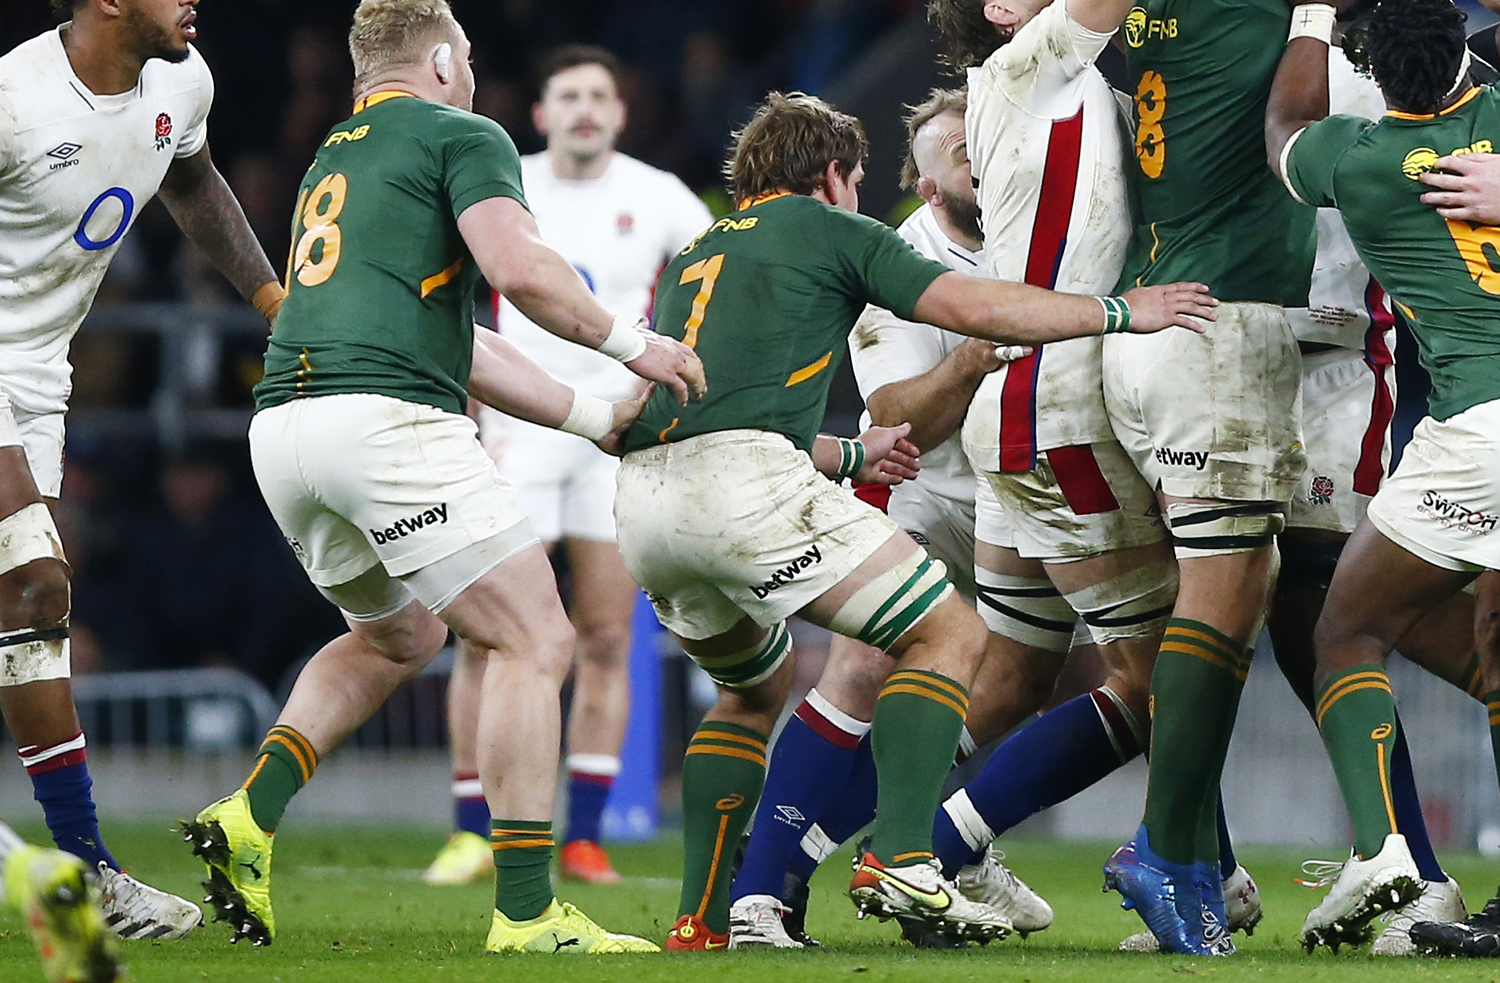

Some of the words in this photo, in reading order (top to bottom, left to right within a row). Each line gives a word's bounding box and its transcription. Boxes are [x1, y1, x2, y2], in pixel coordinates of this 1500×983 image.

[1147, 17, 1179, 40] FNB
[324, 124, 371, 148] FNB
[1134, 70, 1167, 179] 8
[49, 158, 80, 170] umbro
[709, 216, 759, 233] FNB
[679, 253, 726, 351] 7
[1156, 447, 1209, 471] etway
[369, 502, 448, 545] betway
[748, 543, 822, 600] betway
